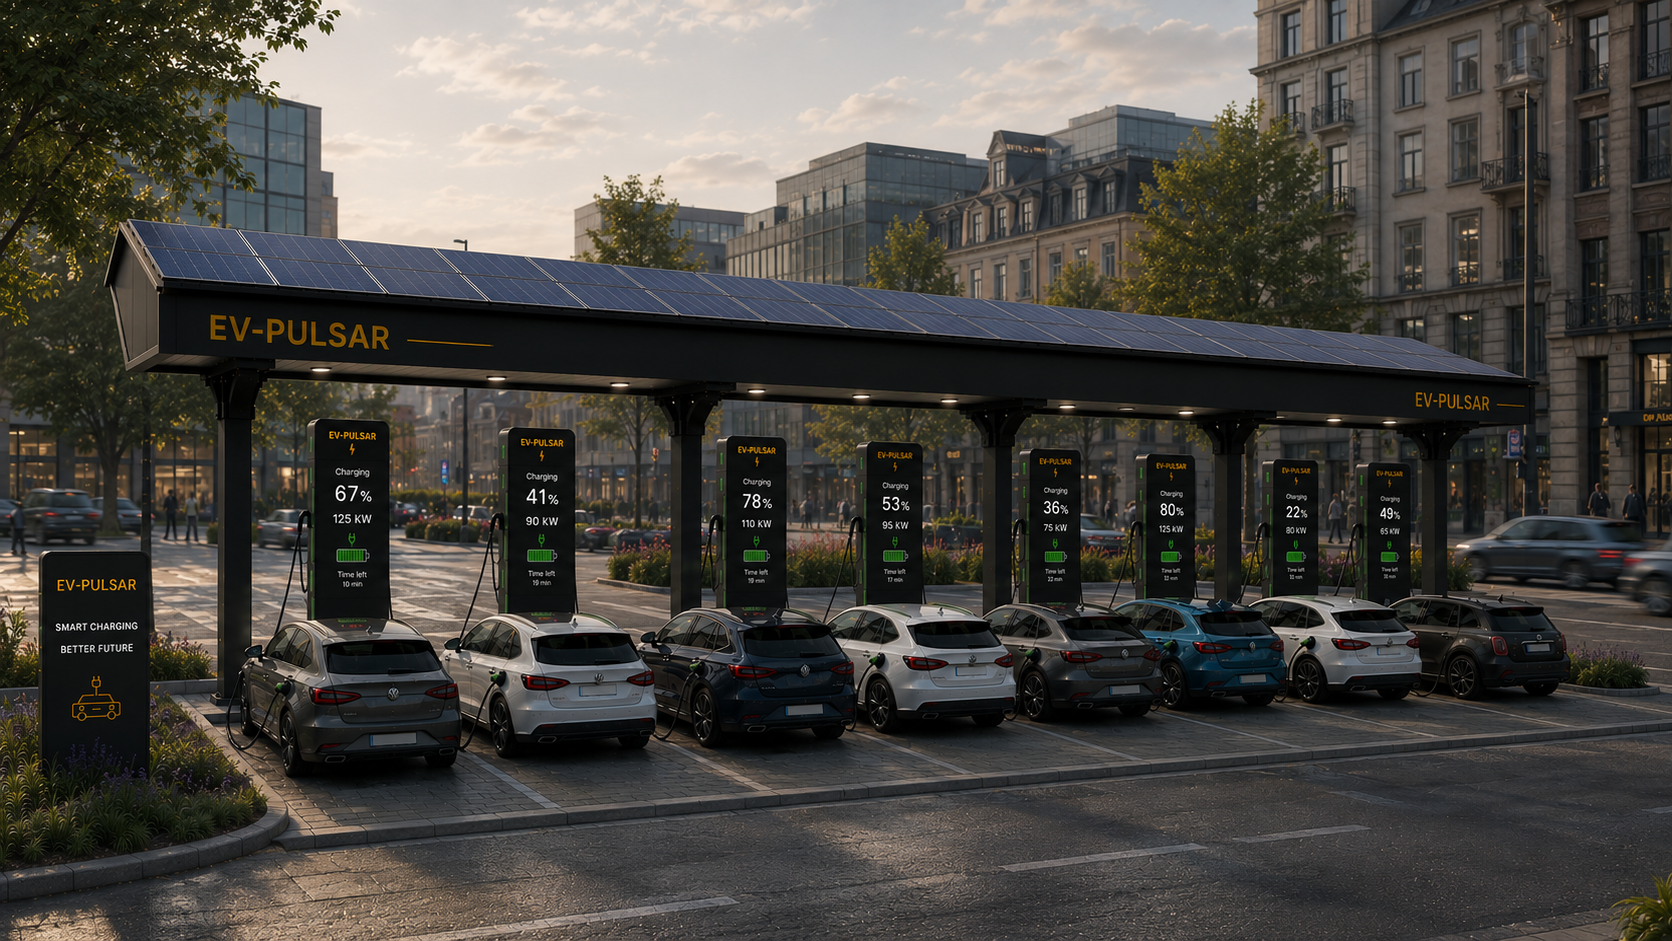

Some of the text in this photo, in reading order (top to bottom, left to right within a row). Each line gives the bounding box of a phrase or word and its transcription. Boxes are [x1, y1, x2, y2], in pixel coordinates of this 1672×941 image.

[210, 314, 390, 351] EV-PULSAR
[1415, 392, 1490, 411] EV-PULSAR
[328, 430, 377, 441] EV-PULSAR
[520, 438, 564, 448] EV-PULSAR
[737, 445, 777, 455] EV-PULSAR
[877, 451, 914, 460] EV-PULSAR
[1039, 457, 1072, 466] EV-PULSAR
[1155, 462, 1187, 470] EV-PULSAR
[334, 467, 371, 479] Charging
[1281, 466, 1311, 474] EV-PULSAR
[1376, 470, 1404, 478] EV-PULSAR
[525, 472, 559, 483] Charging
[742, 477, 772, 488] Charging
[881, 481, 910, 491] Charging
[1043, 486, 1069, 496] Charging
[334, 484, 373, 503] 67%
[525, 487, 560, 506] 41%
[1159, 490, 1184, 499] Charging
[1285, 493, 1308, 502] Charging
[742, 493, 773, 509] 78%
[882, 495, 911, 512] 53%
[1380, 495, 1401, 503] Charging
[1043, 500, 1069, 515] 36%
[1159, 502, 1185, 517] 80%
[1285, 505, 1309, 519] 22%
[1379, 506, 1401, 520] 49%
[332, 513, 373, 524] 125 KW
[525, 516, 559, 527] 90 KW
[741, 519, 772, 529] 110 KW
[881, 520, 910, 530] 95 KW
[1043, 523, 1054, 532] 75
[1158, 525, 1172, 534] 125
[1285, 526, 1296, 535] 80
[1379, 527, 1389, 536] 65
[337, 570, 368, 579] Time left
[527, 569, 556, 577] Time left
[744, 568, 769, 576] Time left
[897, 567, 907, 575] left
[56, 578, 137, 592] EV-PULSAR
[342, 580, 364, 588] 10 min
[540, 579, 552, 587] min
[55, 621, 139, 632] SMART CHARGING
[60, 643, 134, 654] BETTER FUTURE
